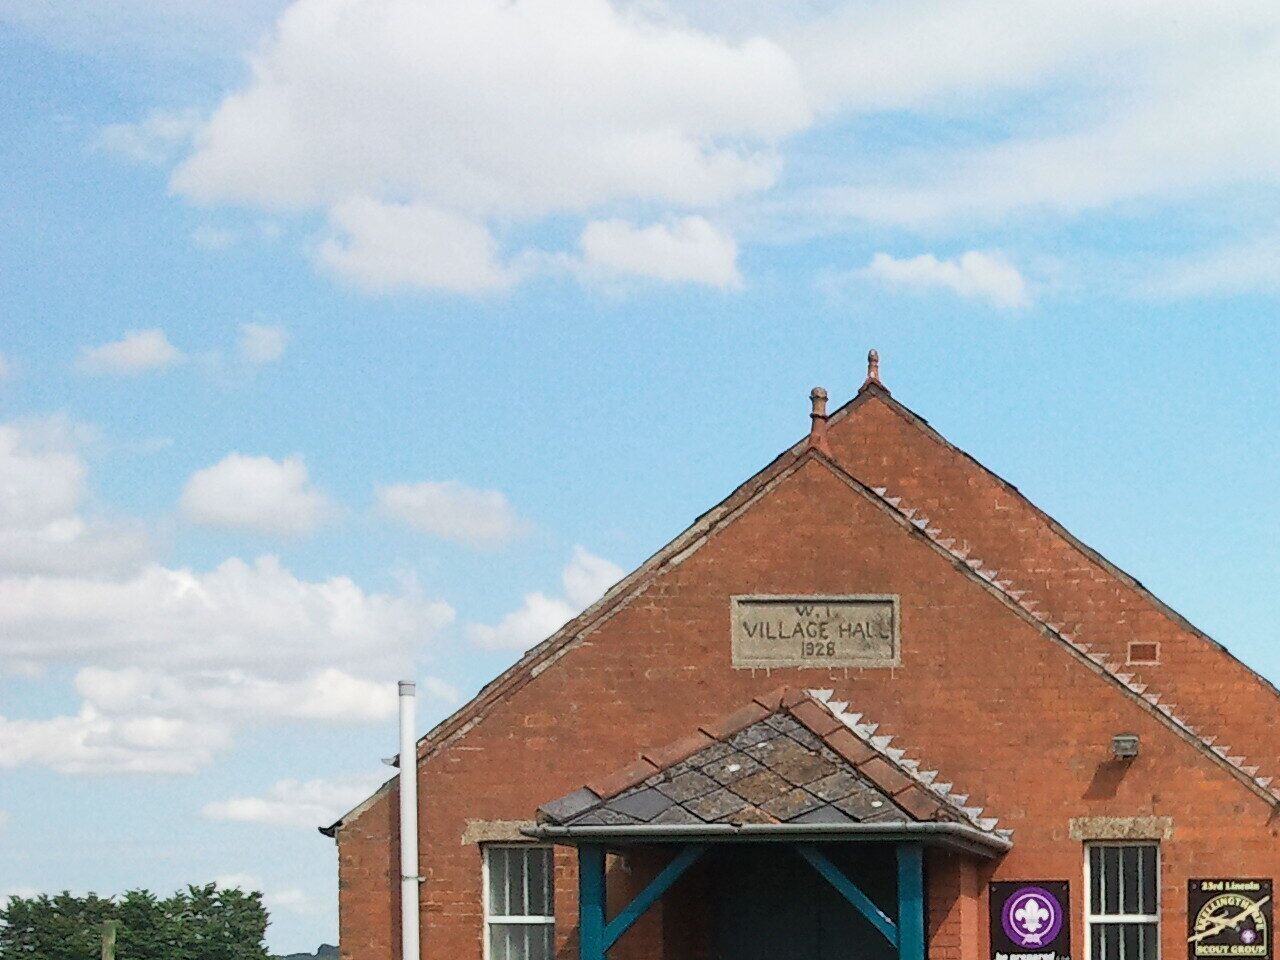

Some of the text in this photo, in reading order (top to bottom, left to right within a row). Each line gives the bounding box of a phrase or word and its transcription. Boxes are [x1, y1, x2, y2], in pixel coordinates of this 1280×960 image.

[742, 621, 889, 639] VILLAGE HALL
[801, 641, 836, 657] 1928
[1197, 945, 1264, 954] SCOUT GROUP
